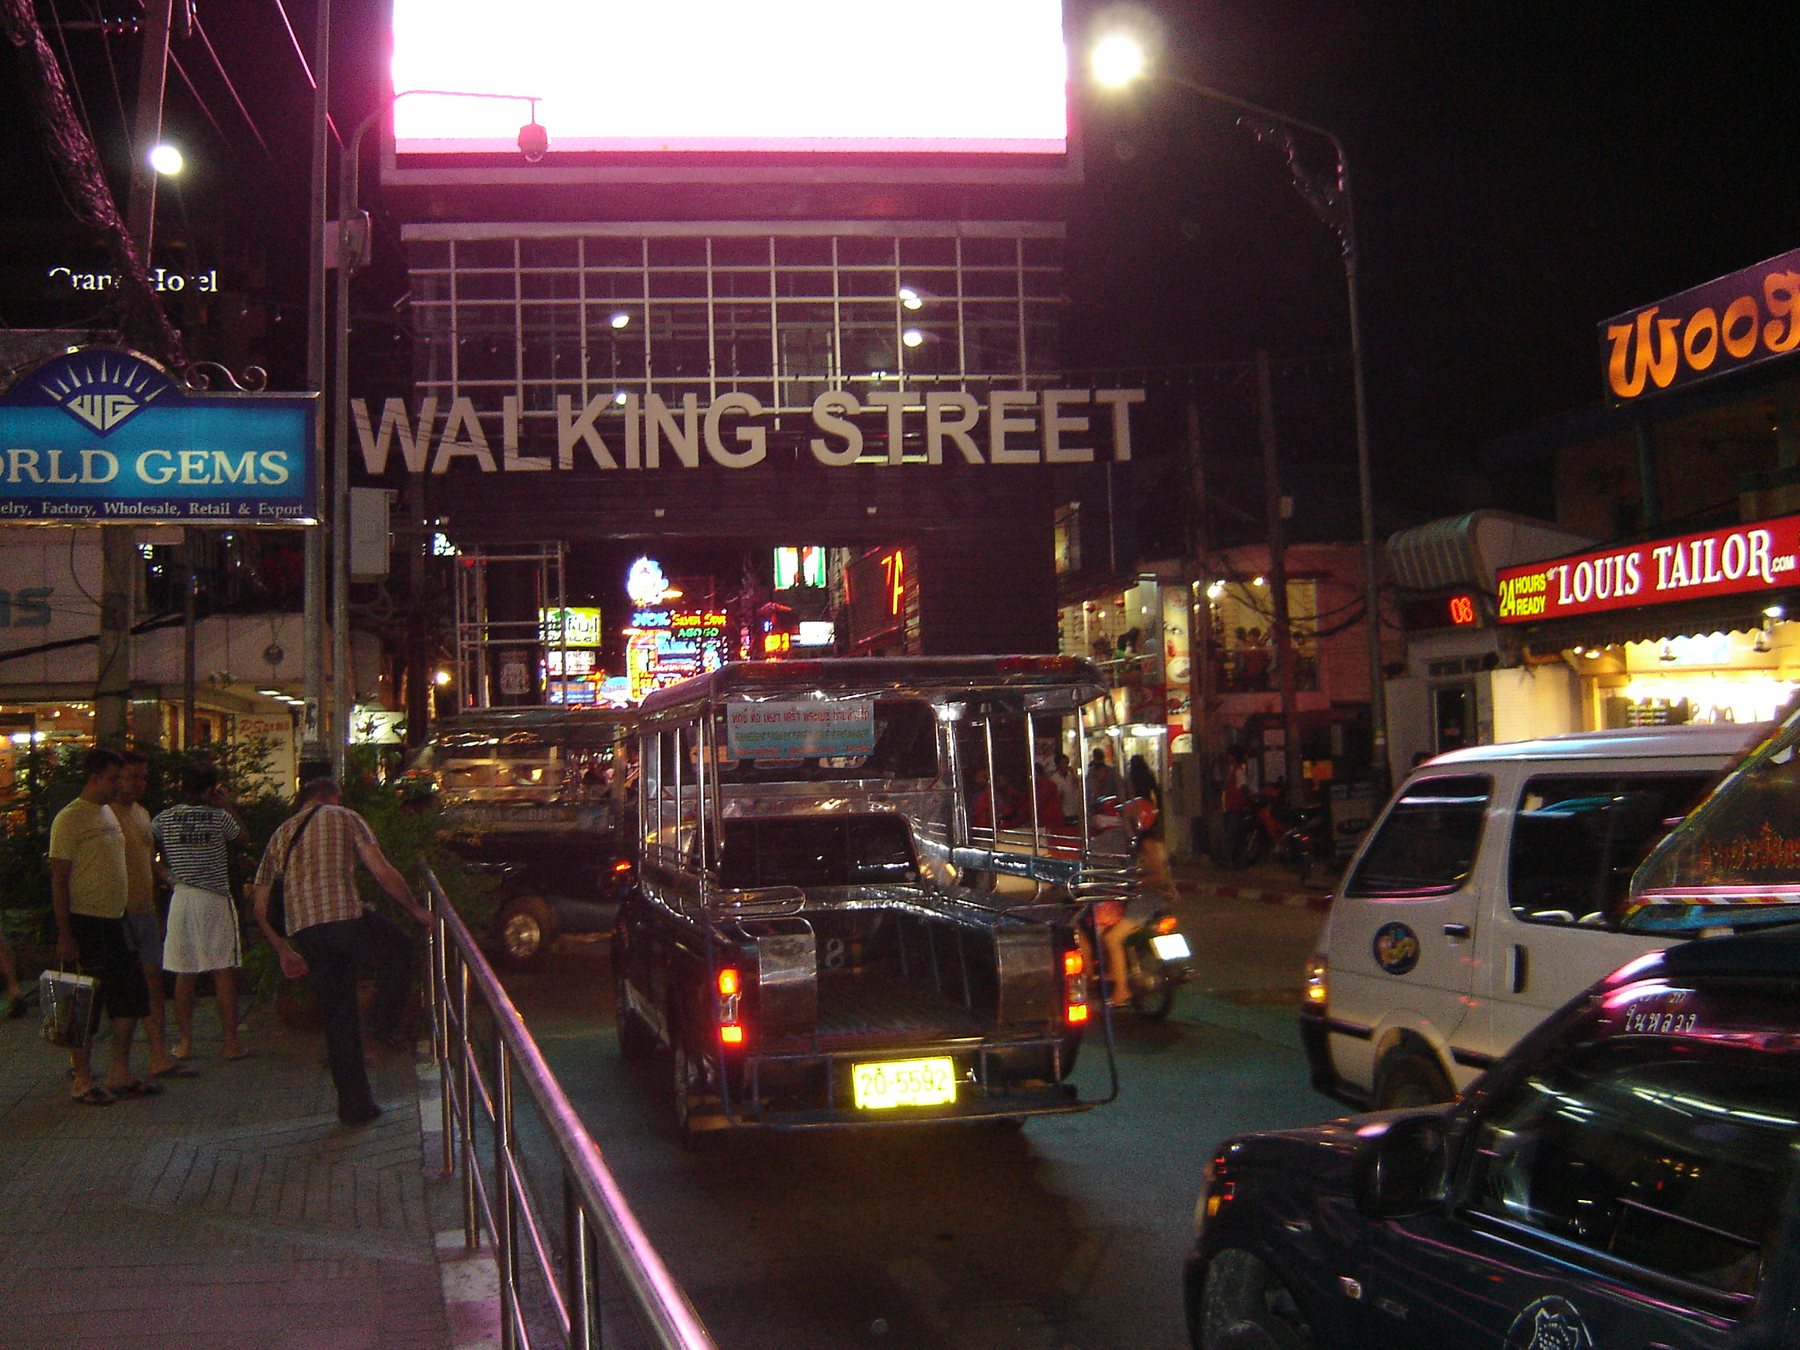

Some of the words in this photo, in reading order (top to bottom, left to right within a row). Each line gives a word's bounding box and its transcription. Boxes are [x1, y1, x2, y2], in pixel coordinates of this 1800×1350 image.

[350, 392, 768, 475] WALKING
[809, 388, 1147, 467] STREET
[0, 448, 119, 484] RLD
[135, 449, 289, 485] GEMS
[42, 502, 97, 518] Factory,
[104, 502, 181, 517] Wholesale,
[189, 502, 230, 515] Retail
[238, 503, 250, 514] &
[258, 503, 304, 517] Export
[1498, 578, 1516, 617] 24
[1515, 573, 1546, 595] HOURS
[1516, 595, 1546, 616] READY
[1625, 1004, 1697, 1033] ในหลวง
